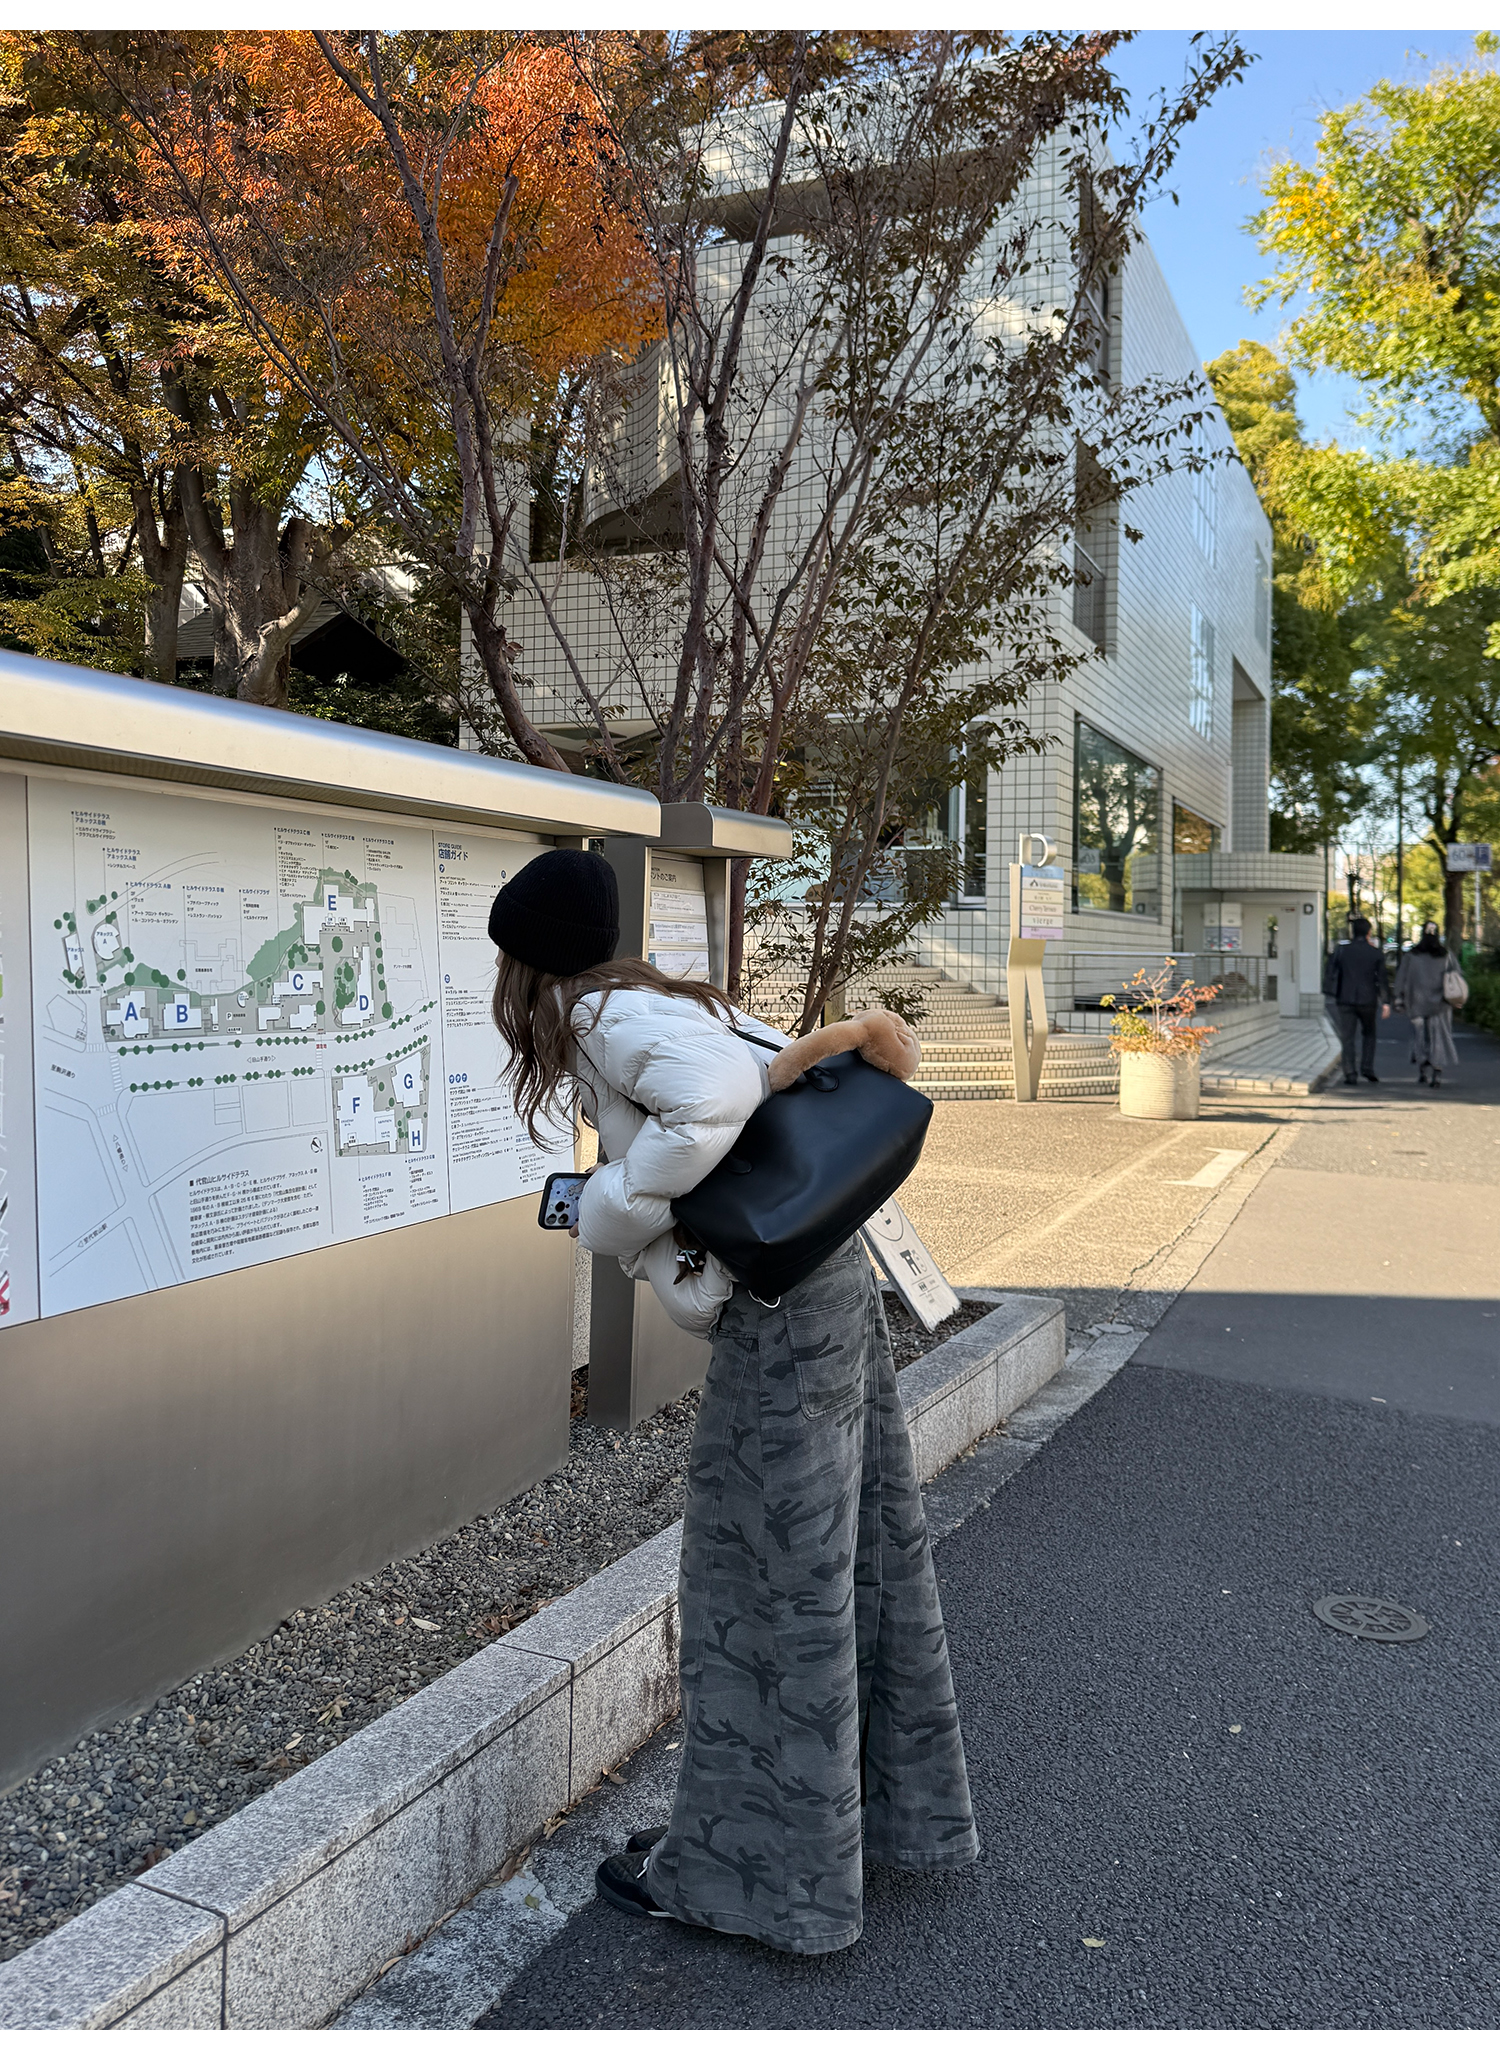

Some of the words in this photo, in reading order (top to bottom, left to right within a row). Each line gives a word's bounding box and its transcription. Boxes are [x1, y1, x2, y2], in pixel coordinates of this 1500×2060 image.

[438, 848, 469, 861] 店舗ガイド
[328, 895, 337, 910] E
[1303, 903, 1315, 915] D
[292, 973, 304, 991] C
[124, 1001, 139, 1021] A
[359, 994, 369, 1011] D
[176, 1004, 190, 1023] B
[404, 1073, 413, 1089] G
[353, 1097, 360, 1114] F
[412, 1130, 421, 1147] H
[195, 1169, 250, 1186] 代官山ヒルサイドテラス
